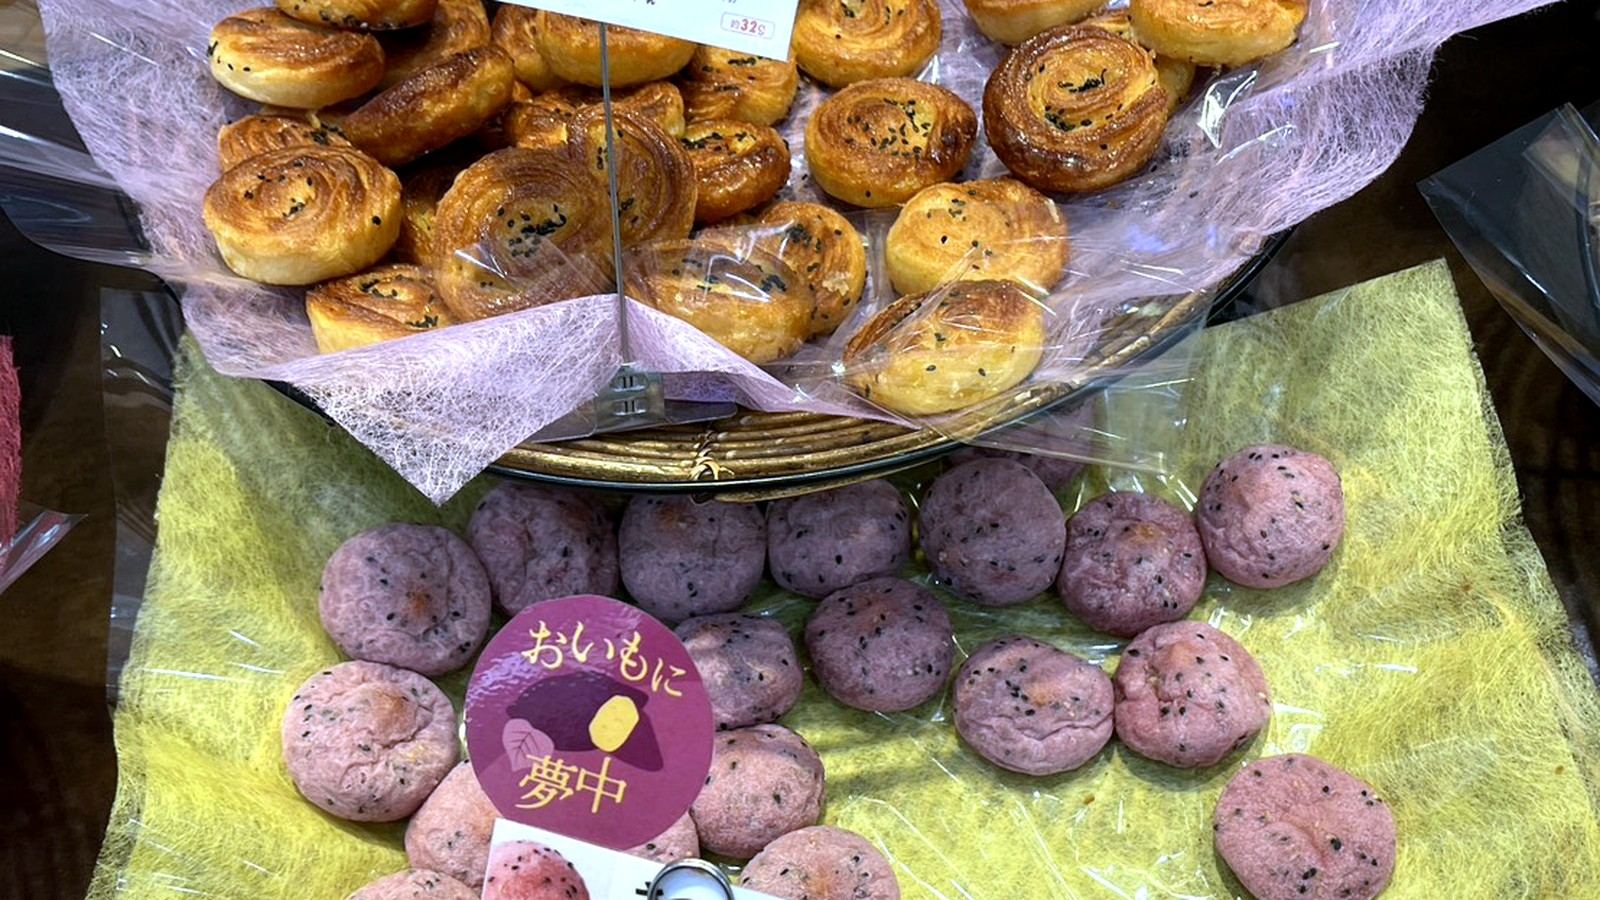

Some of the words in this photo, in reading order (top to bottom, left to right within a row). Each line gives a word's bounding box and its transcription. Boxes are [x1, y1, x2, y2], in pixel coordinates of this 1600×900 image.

[521, 621, 687, 697] おいもに
[515, 754, 627, 813] 夢中
